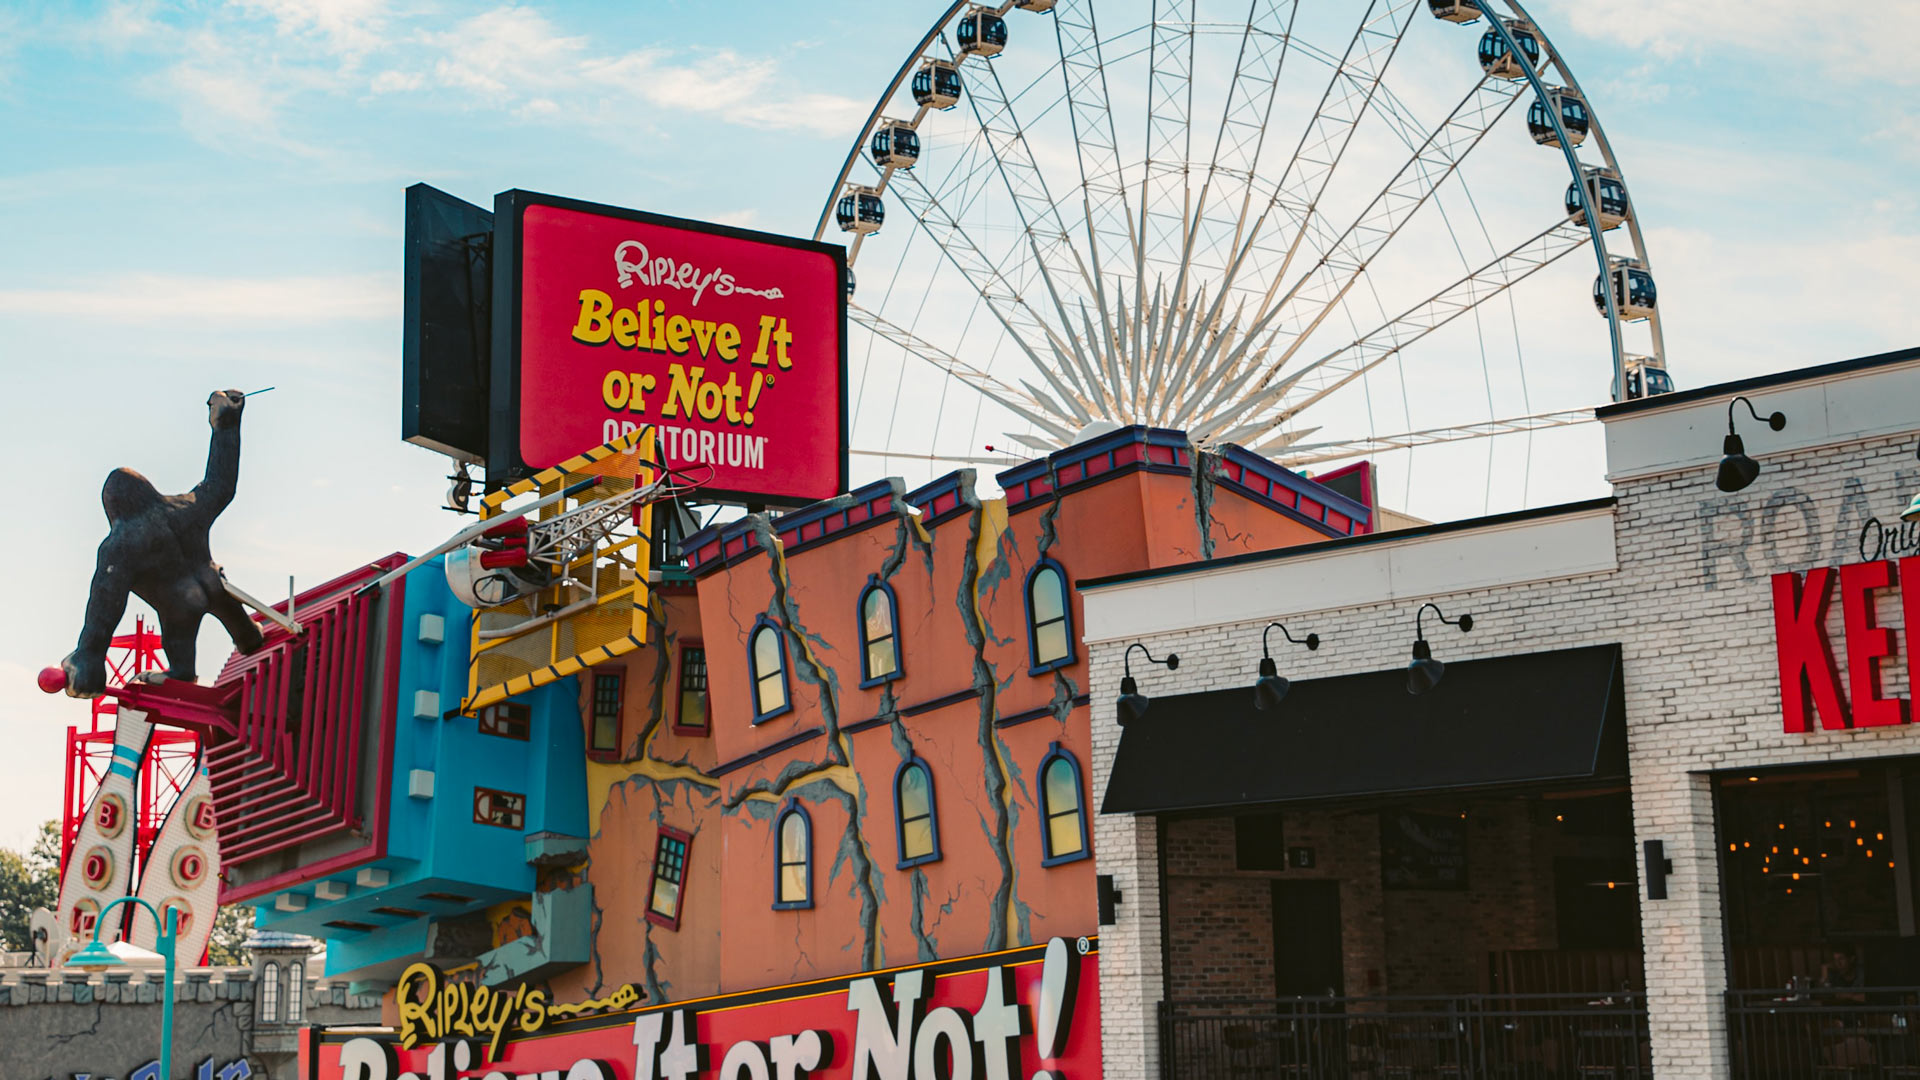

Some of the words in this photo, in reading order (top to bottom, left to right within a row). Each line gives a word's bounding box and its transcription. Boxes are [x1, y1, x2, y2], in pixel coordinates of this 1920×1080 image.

[572, 289, 741, 361] Believe
[751, 315, 792, 369] It
[602, 370, 655, 412] or
[603, 419, 764, 469] ODITORIUM
